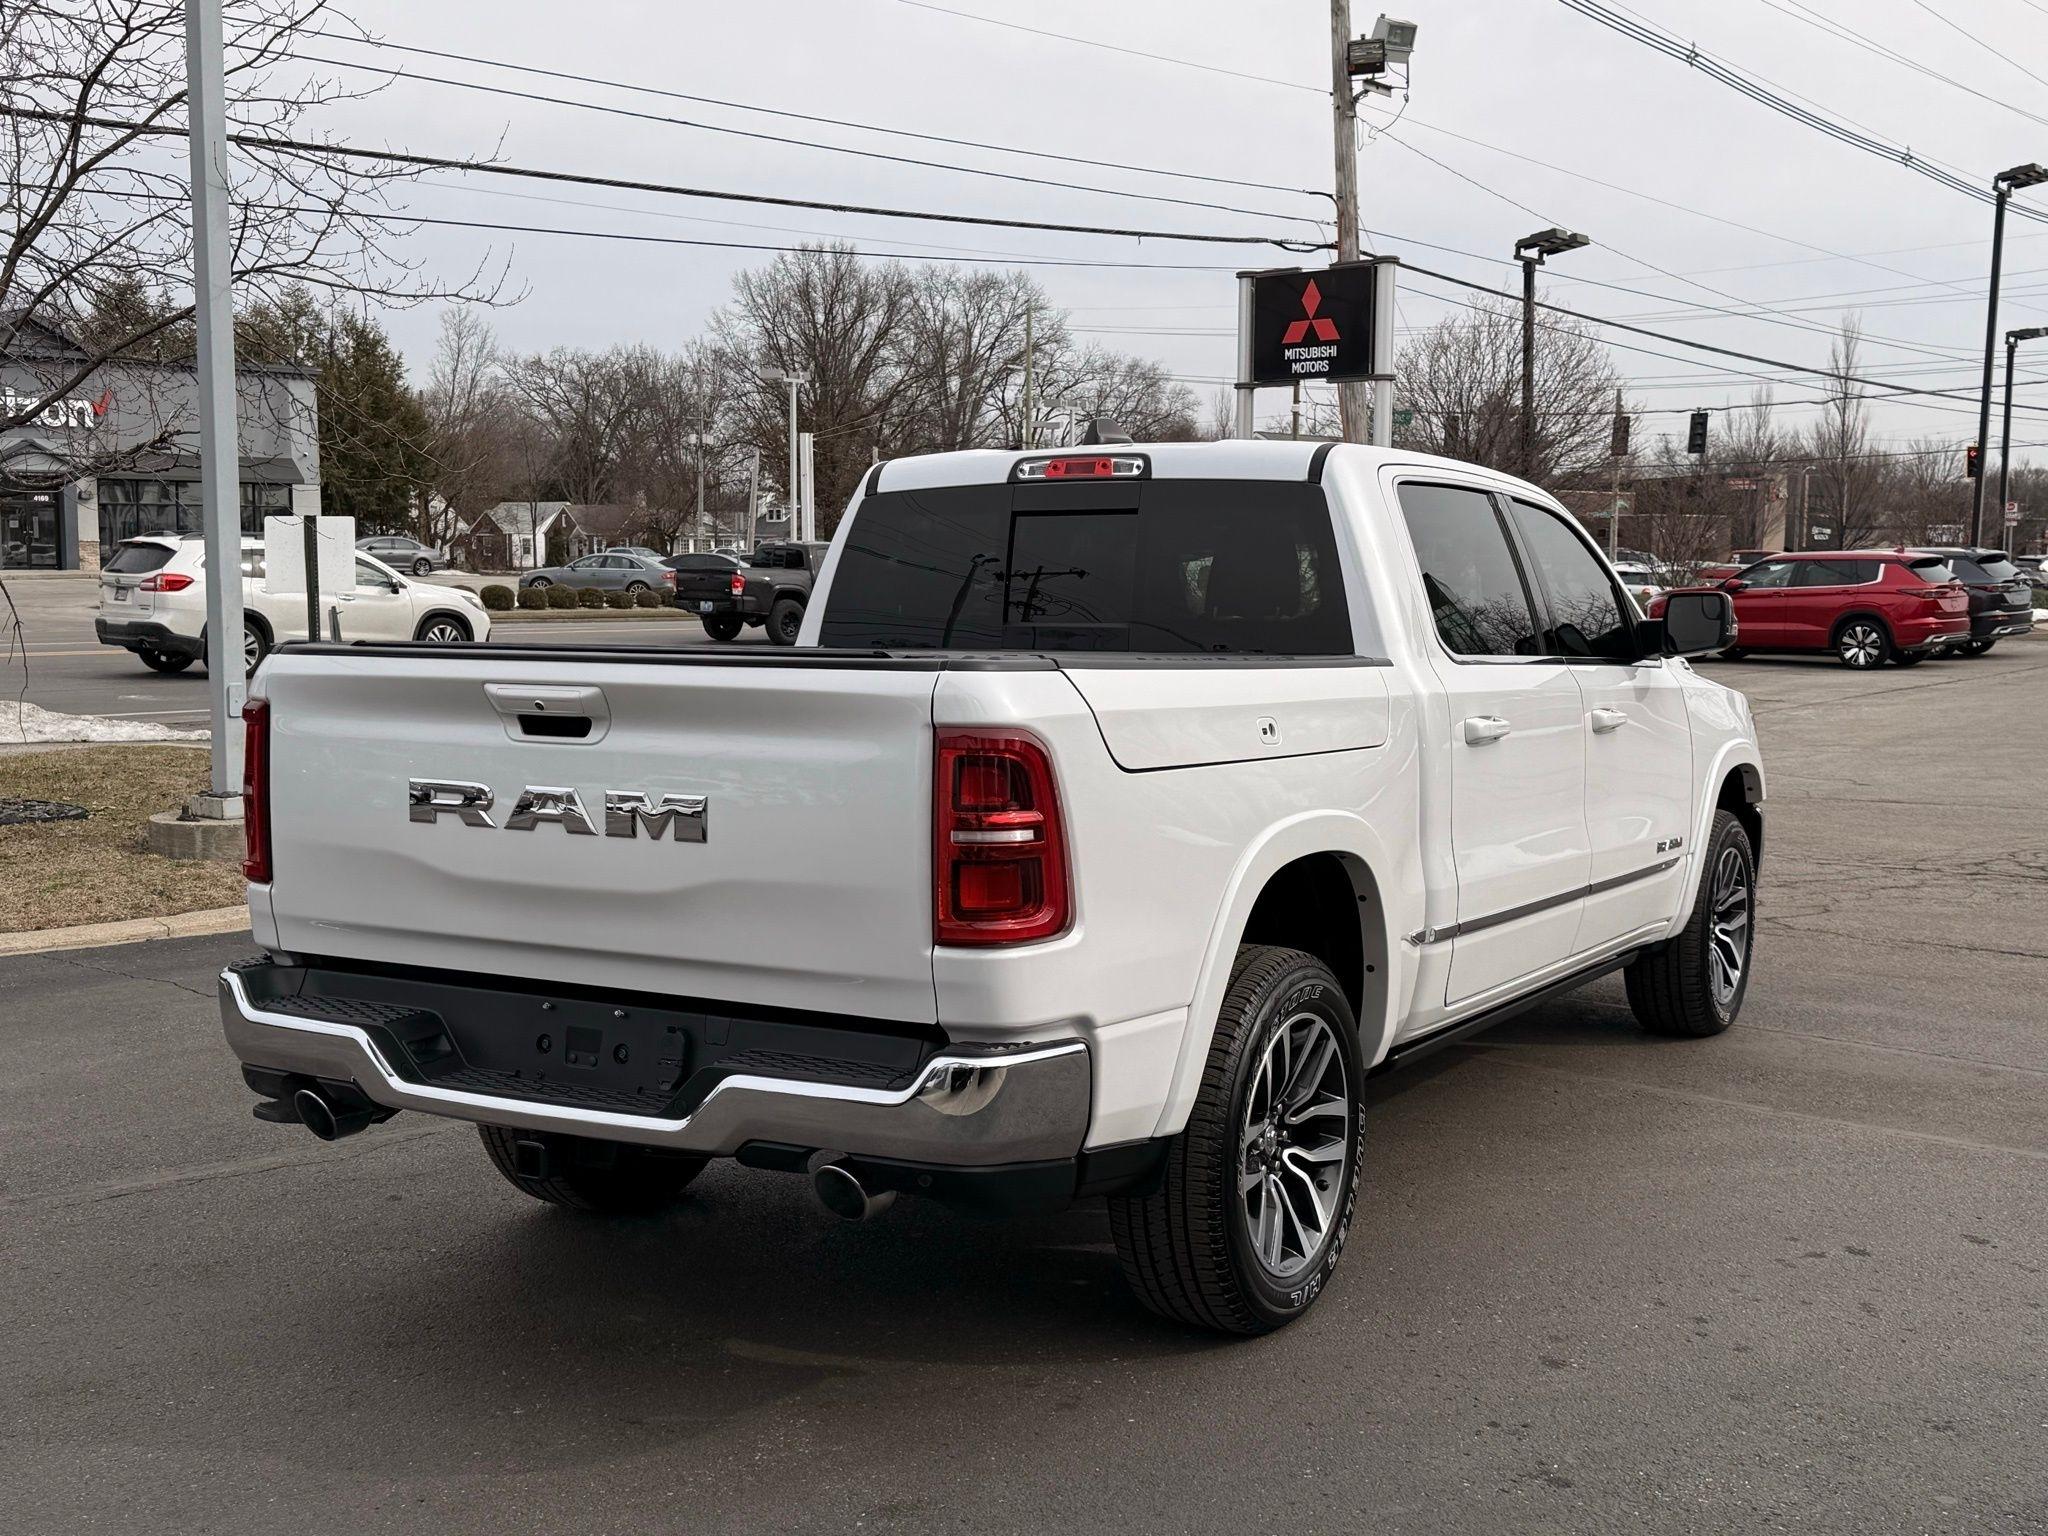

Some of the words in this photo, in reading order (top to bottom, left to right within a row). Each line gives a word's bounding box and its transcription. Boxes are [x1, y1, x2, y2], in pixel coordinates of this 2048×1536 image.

[1284, 345, 1337, 360] MITSUBISHI
[1291, 360, 1329, 374] MOTORS
[409, 777, 708, 844] RAM
